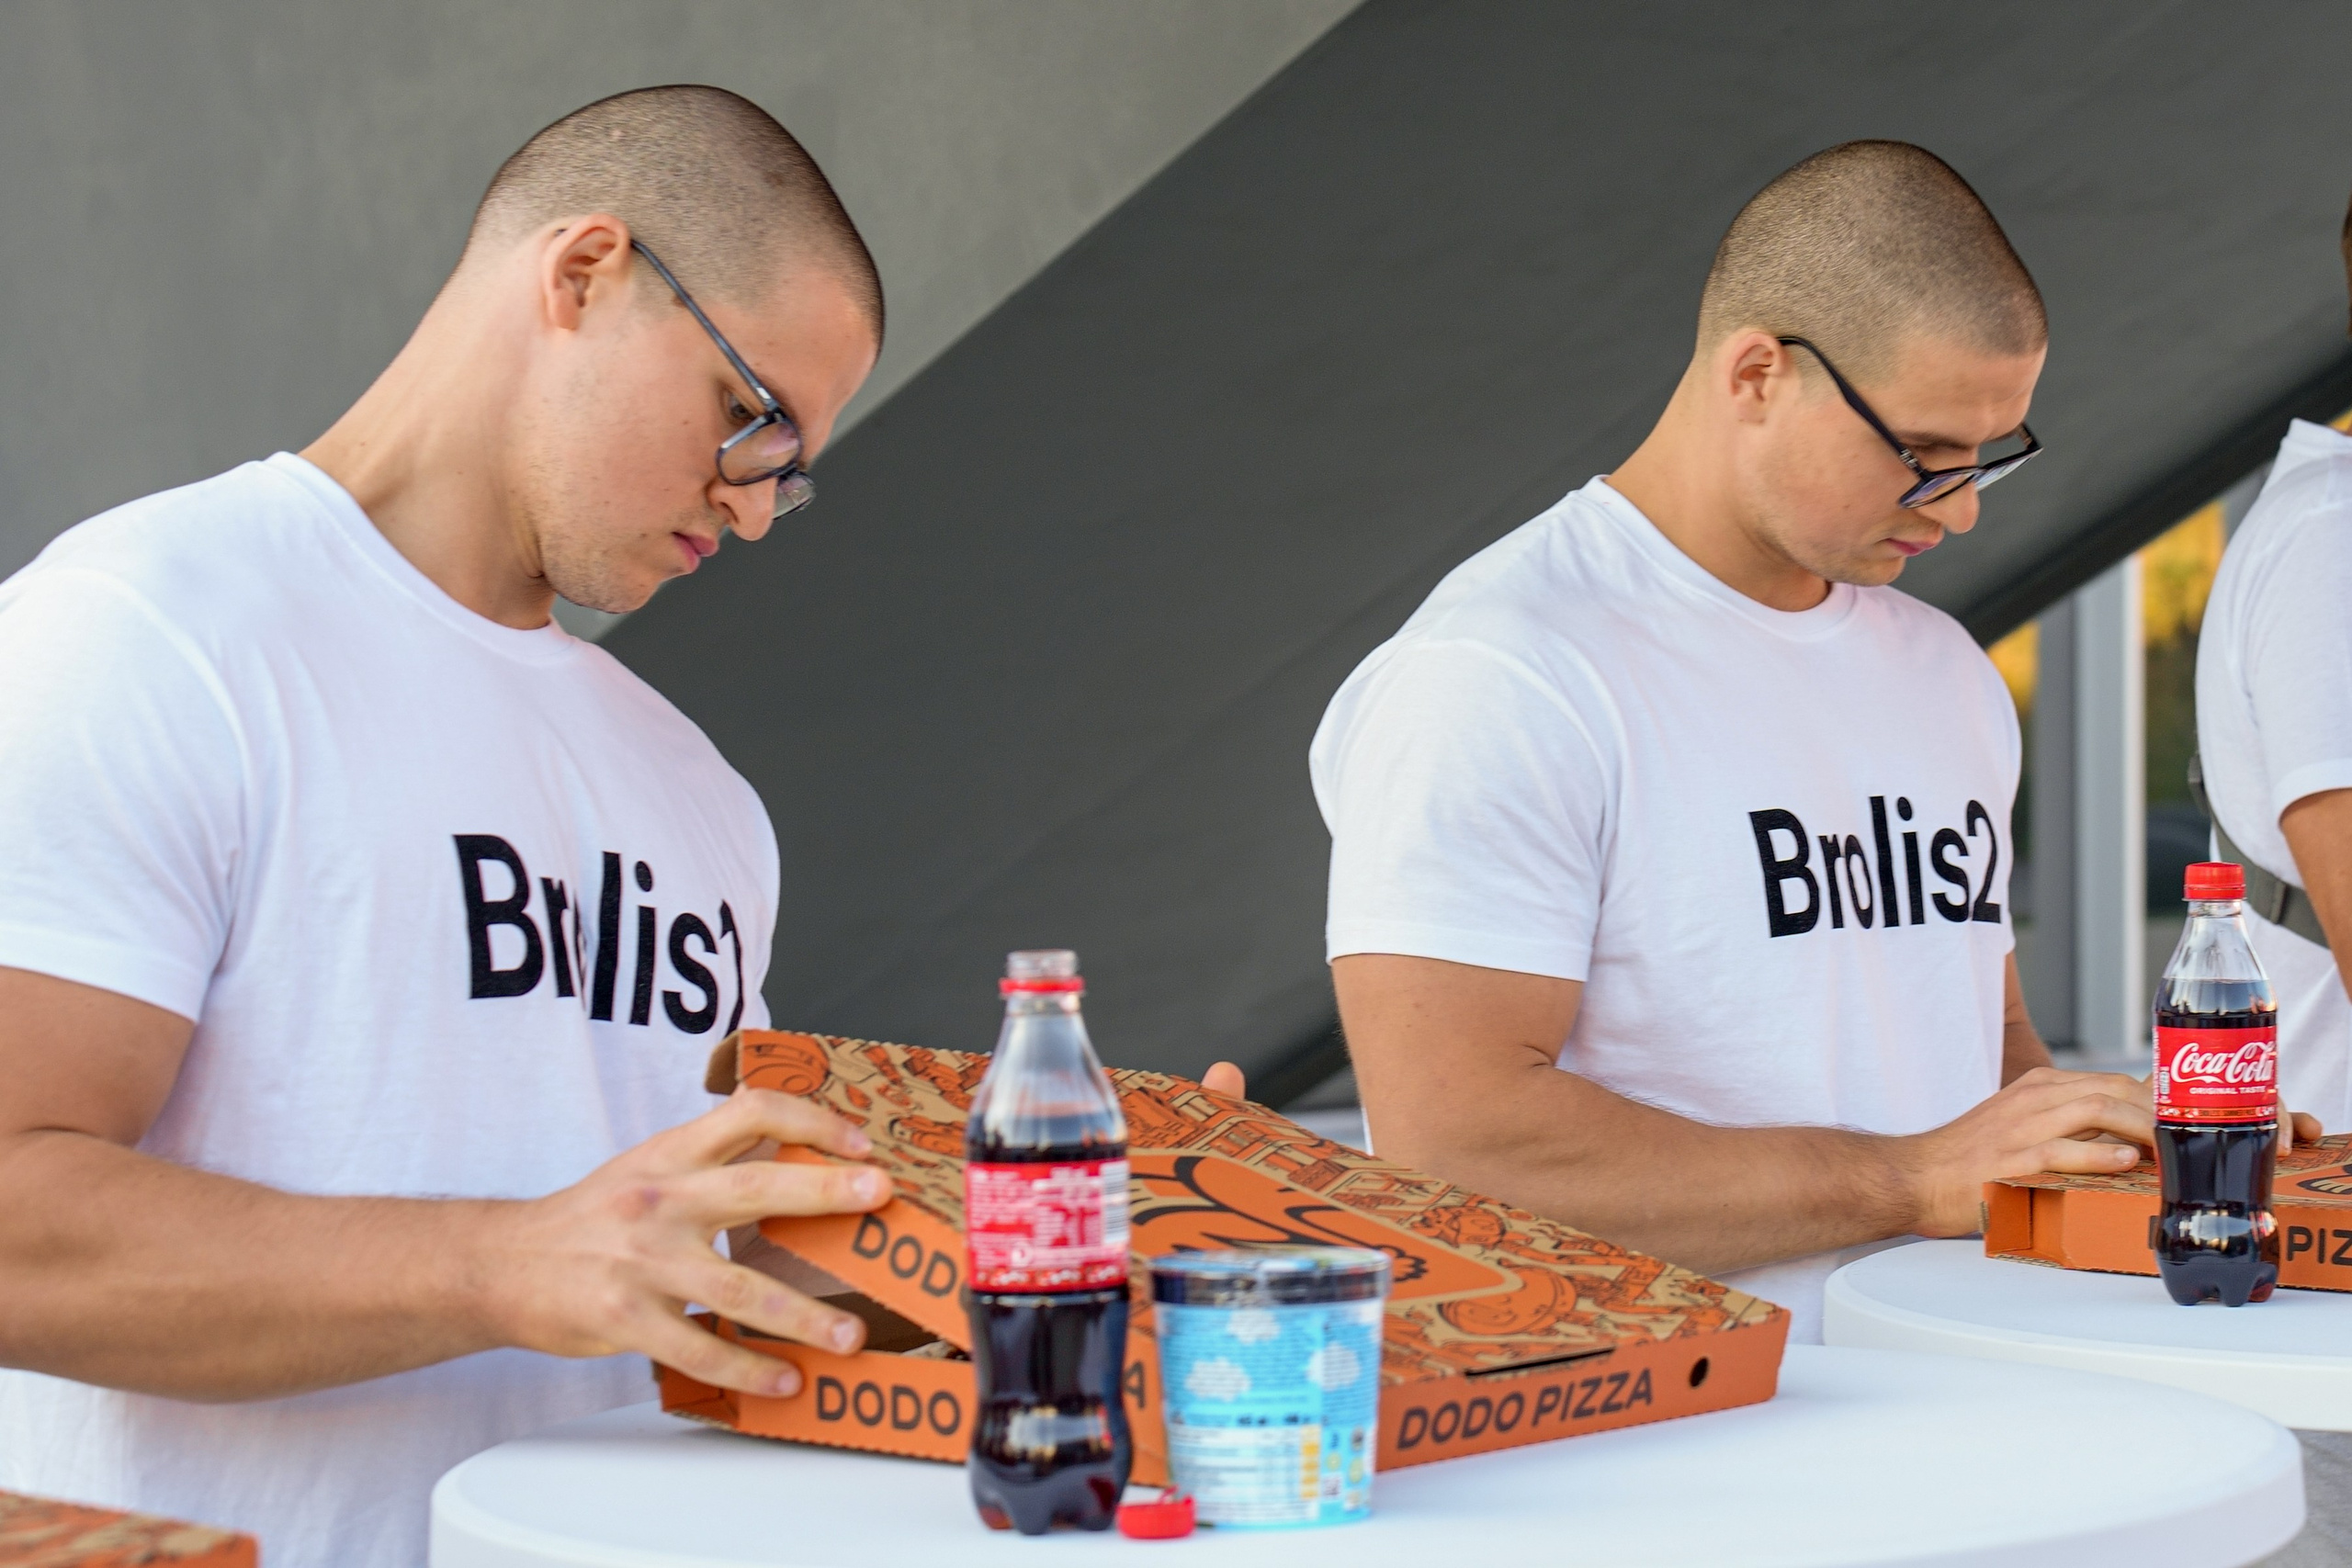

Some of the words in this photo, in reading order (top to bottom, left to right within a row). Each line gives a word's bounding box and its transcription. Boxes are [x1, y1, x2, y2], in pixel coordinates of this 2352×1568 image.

[1748, 795, 2002, 938] Brolis2
[2170, 1041, 2276, 1083] Coca-Cola
[852, 1213, 970, 1314] DOD
[816, 1375, 961, 1436] DODO
[1396, 1391, 1524, 1450] DODO
[1532, 1367, 1653, 1427] PIZZA
